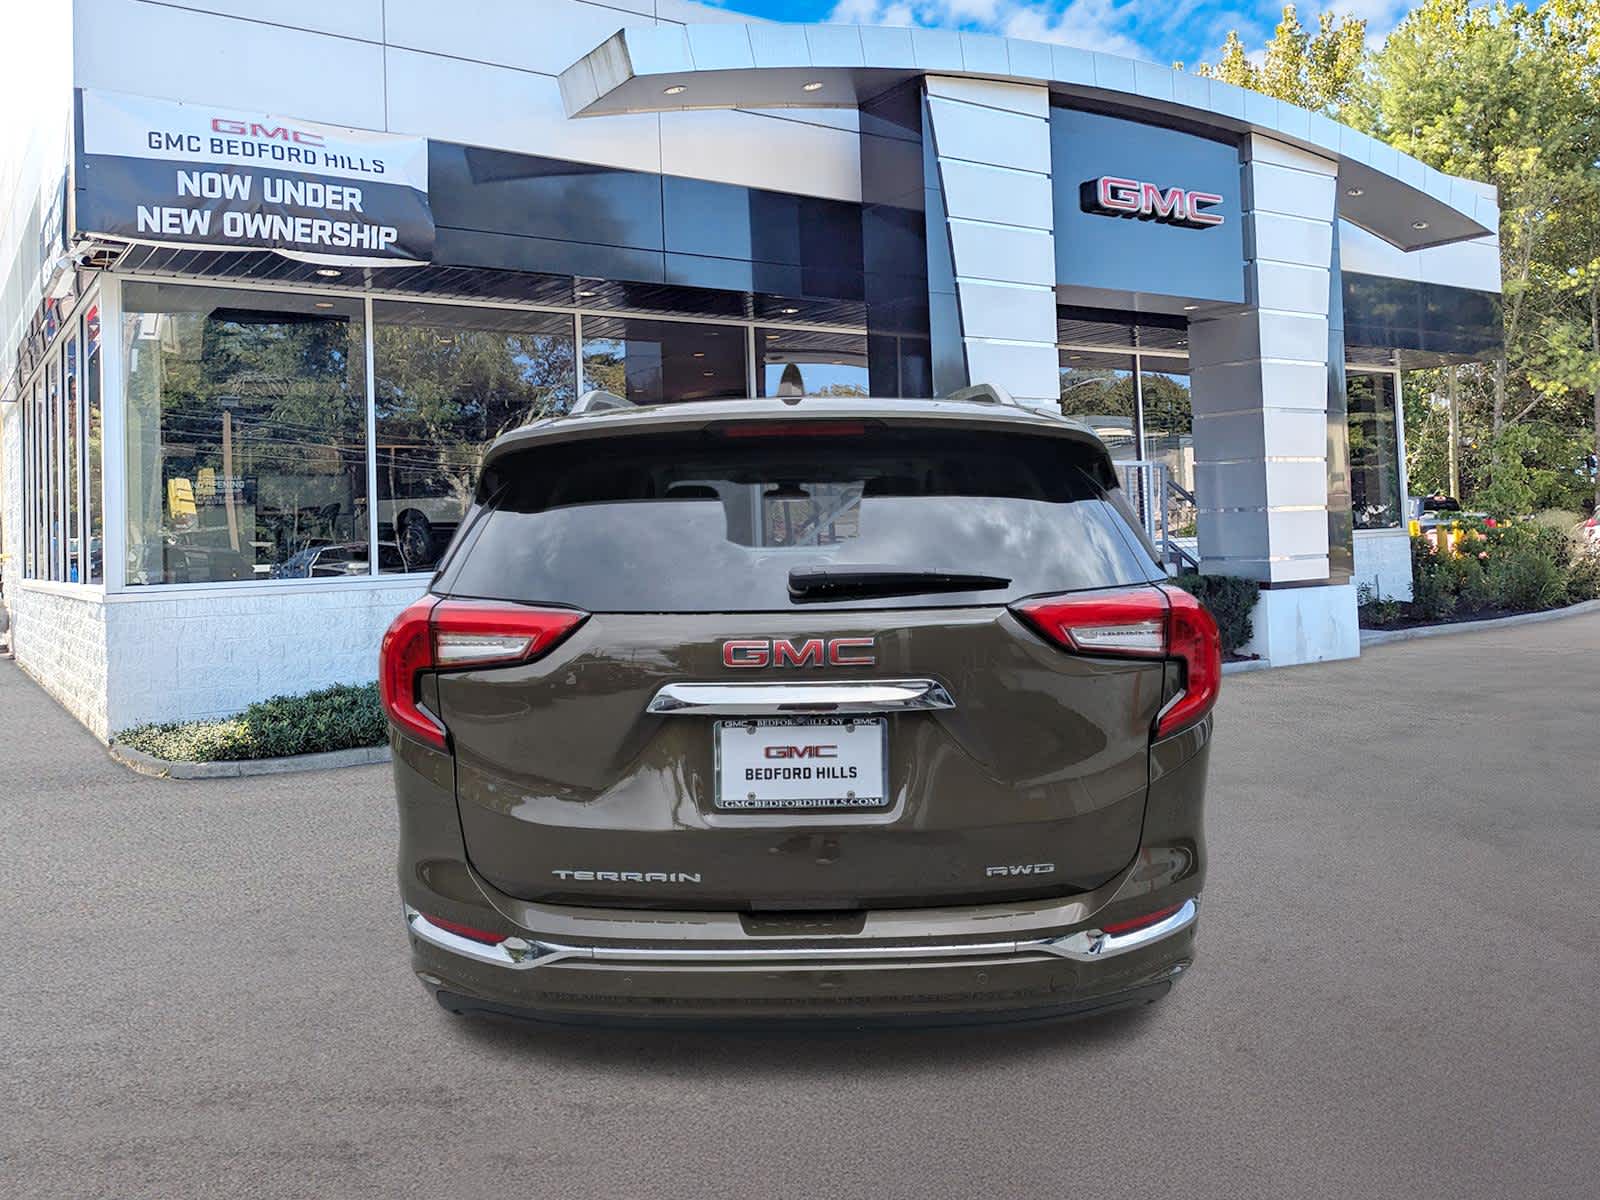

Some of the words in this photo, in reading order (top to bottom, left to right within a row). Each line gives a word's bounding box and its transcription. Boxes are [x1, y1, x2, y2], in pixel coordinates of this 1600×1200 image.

[211, 118, 326, 148] GMC
[148, 131, 200, 152] GMC
[210, 138, 317, 166] BEDFORD
[324, 153, 385, 174] HILLS
[177, 170, 252, 201] NOW
[263, 176, 364, 213] UNDER
[1097, 175, 1225, 225] GMC
[136, 205, 211, 236] NEW
[223, 211, 398, 250] OWNERSHIP
[723, 638, 875, 667] GMC
[724, 719, 747, 728] GMC
[757, 718, 798, 727] BEDFOR
[831, 717, 843, 726] NY
[853, 717, 877, 726] GMC
[764, 745, 838, 759] GMC
[745, 767, 812, 781] BEDFORD
[816, 766, 857, 779] HILLS
[724, 799, 880, 808] GMCBEDFORDHILLS.COM
[552, 869, 701, 883] TERRAIN
[986, 863, 1055, 876] AWD
